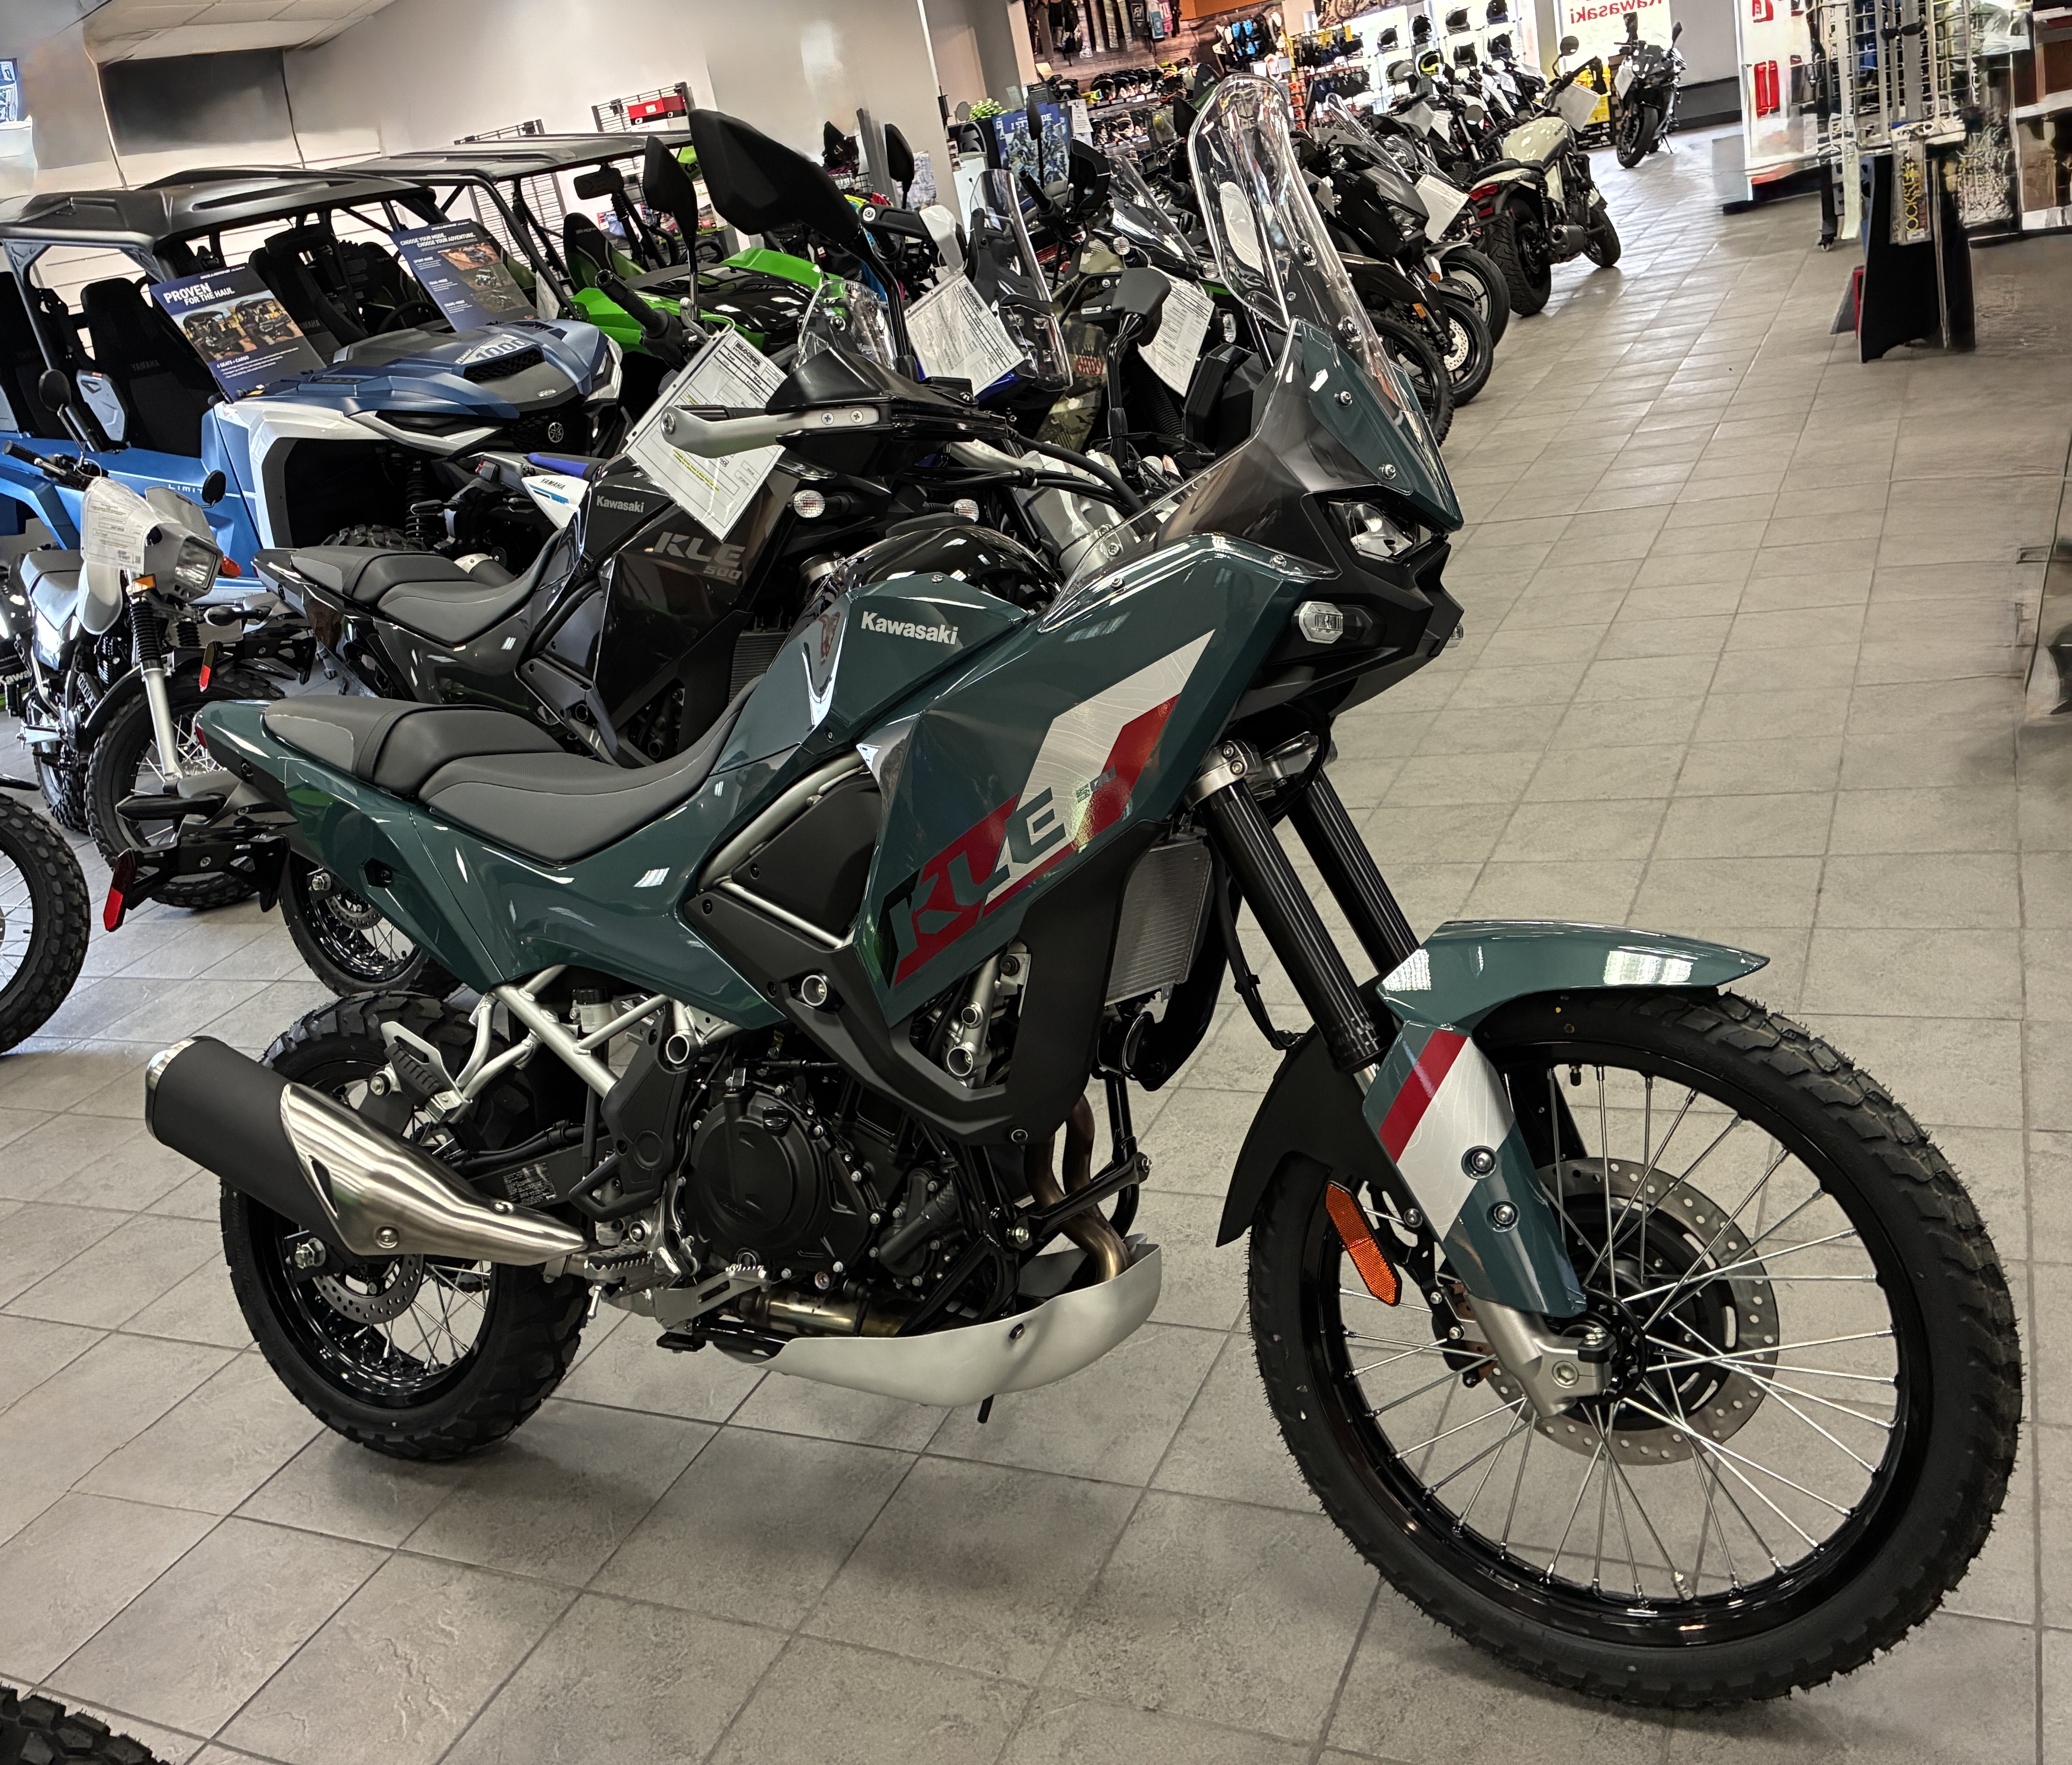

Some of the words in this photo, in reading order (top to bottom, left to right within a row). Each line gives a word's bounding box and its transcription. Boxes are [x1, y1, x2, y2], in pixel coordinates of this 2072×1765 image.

[163, 282, 212, 304] PROVEN
[184, 297, 201, 306] FOR
[200, 292, 216, 302] THE
[215, 287, 235, 298] HAUL
[476, 339, 527, 361] 1000
[726, 352, 736, 361] Year
[541, 478, 566, 490] YAMAHA
[597, 495, 645, 513] Kawasaki
[654, 530, 746, 567] KLE
[703, 565, 742, 579] 500
[861, 611, 958, 645] Kawasaki
[1076, 765, 1117, 803] 500
[889, 786, 1067, 962] KLE
